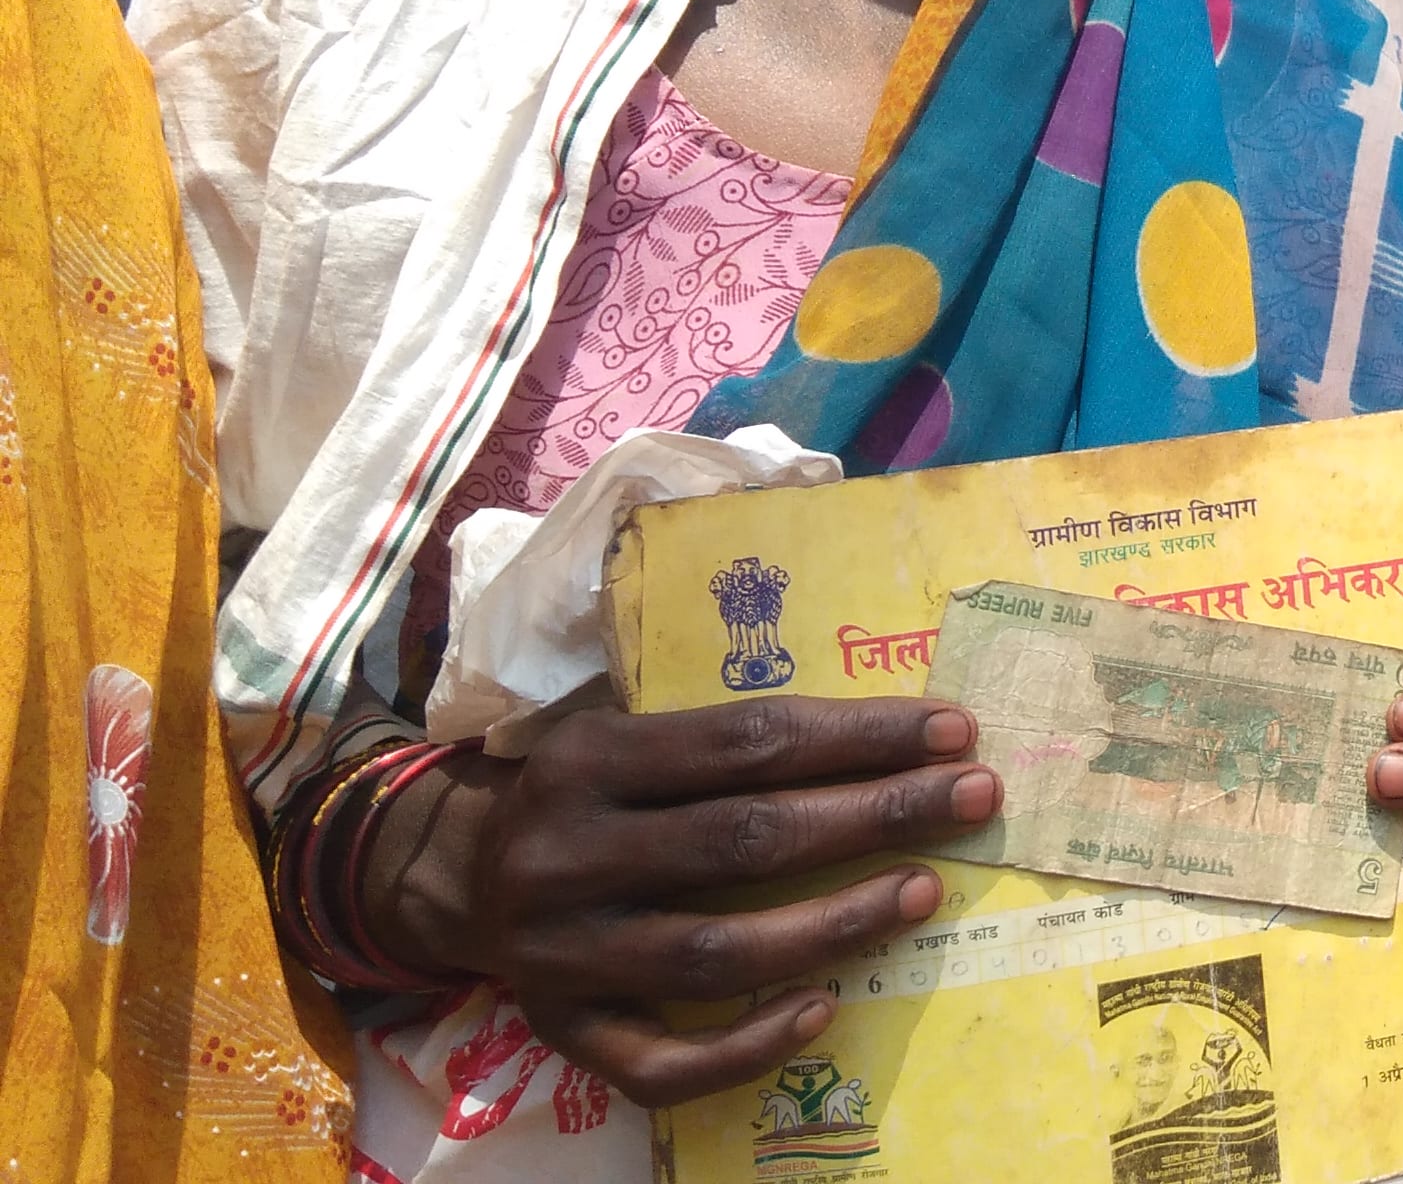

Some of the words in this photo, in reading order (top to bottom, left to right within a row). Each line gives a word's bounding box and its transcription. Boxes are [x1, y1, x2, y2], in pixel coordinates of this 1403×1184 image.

[1028, 517, 1102, 550] ग्रामीण
[1108, 508, 1181, 538] विकास
[1188, 498, 1258, 526] विभाग
[1078, 543, 1150, 569] झारखण्ड
[1160, 532, 1217, 556] सरकार
[967, 592, 1044, 619] RUPEES
[1051, 603, 1093, 627] FIVE
[1163, 850, 1236, 878] भारतीय
[1355, 856, 1382, 895] 5
[914, 931, 960, 952] प्रखण्ड
[967, 924, 999, 941] कोड
[1037, 908, 1085, 928] पंचायत
[1094, 901, 1123, 918] कोड
[1365, 1035, 1396, 1050] वैधता
[799, 1066, 819, 1075] 100
